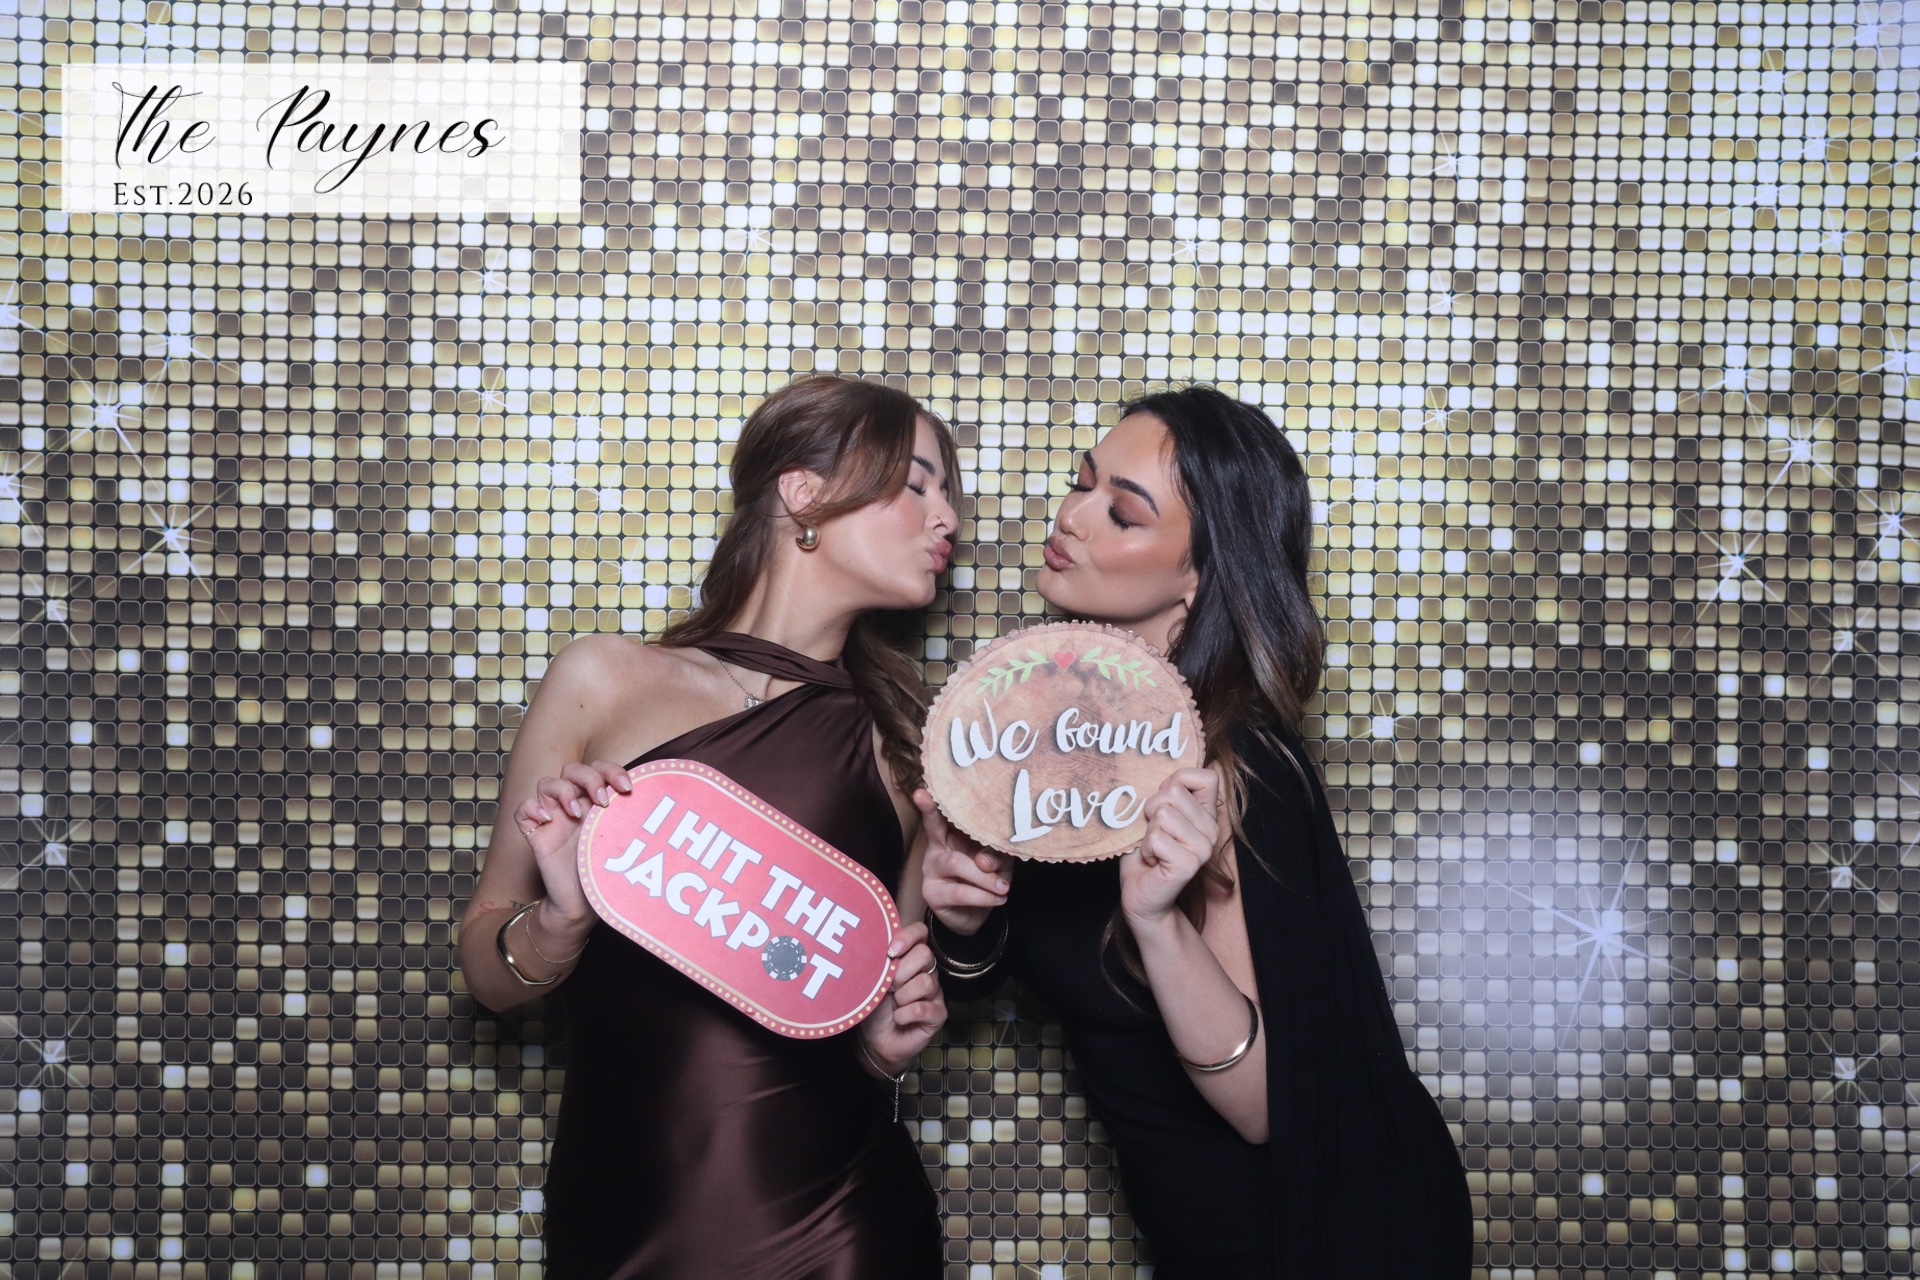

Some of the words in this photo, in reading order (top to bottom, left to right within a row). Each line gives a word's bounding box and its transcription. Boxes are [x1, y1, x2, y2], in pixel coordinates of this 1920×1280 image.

[950, 698, 1039, 767] We
[1056, 707, 1189, 759] found
[1009, 768, 1147, 843] Love
[641, 795, 676, 835] I
[667, 810, 763, 885] HIT
[760, 864, 861, 954] THE
